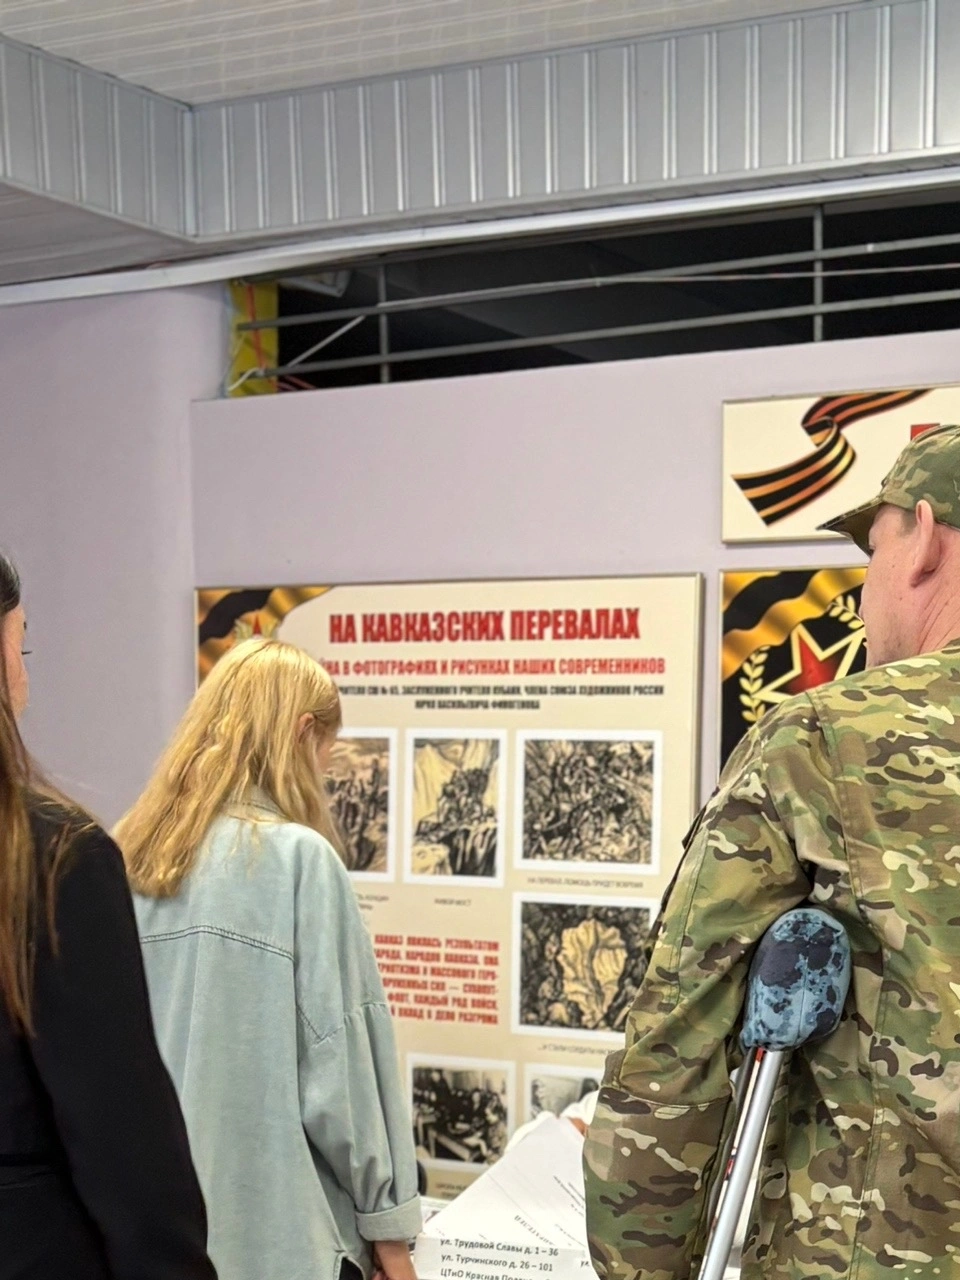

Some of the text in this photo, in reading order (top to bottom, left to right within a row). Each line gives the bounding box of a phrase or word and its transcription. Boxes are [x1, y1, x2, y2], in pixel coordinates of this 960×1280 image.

[329, 608, 640, 643] НА КАВКАЗСКИХ ПЕРЕВАЛАХ
[343, 660, 350, 675] В
[352, 659, 437, 676] ФОТОГРАФИЯХ
[441, 660, 448, 675] И
[451, 659, 510, 675] РИСУНКАХ
[513, 659, 556, 675] НАШИХ
[559, 657, 666, 675] СОВРЕМЕННИКОВ
[455, 1239, 494, 1250] Трудовой
[496, 1243, 522, 1253] Славы
[456, 1254, 508, 1267] Турчинского
[539, 1263, 553, 1271] 101
[440, 1268, 463, 1278] ЦТиО
